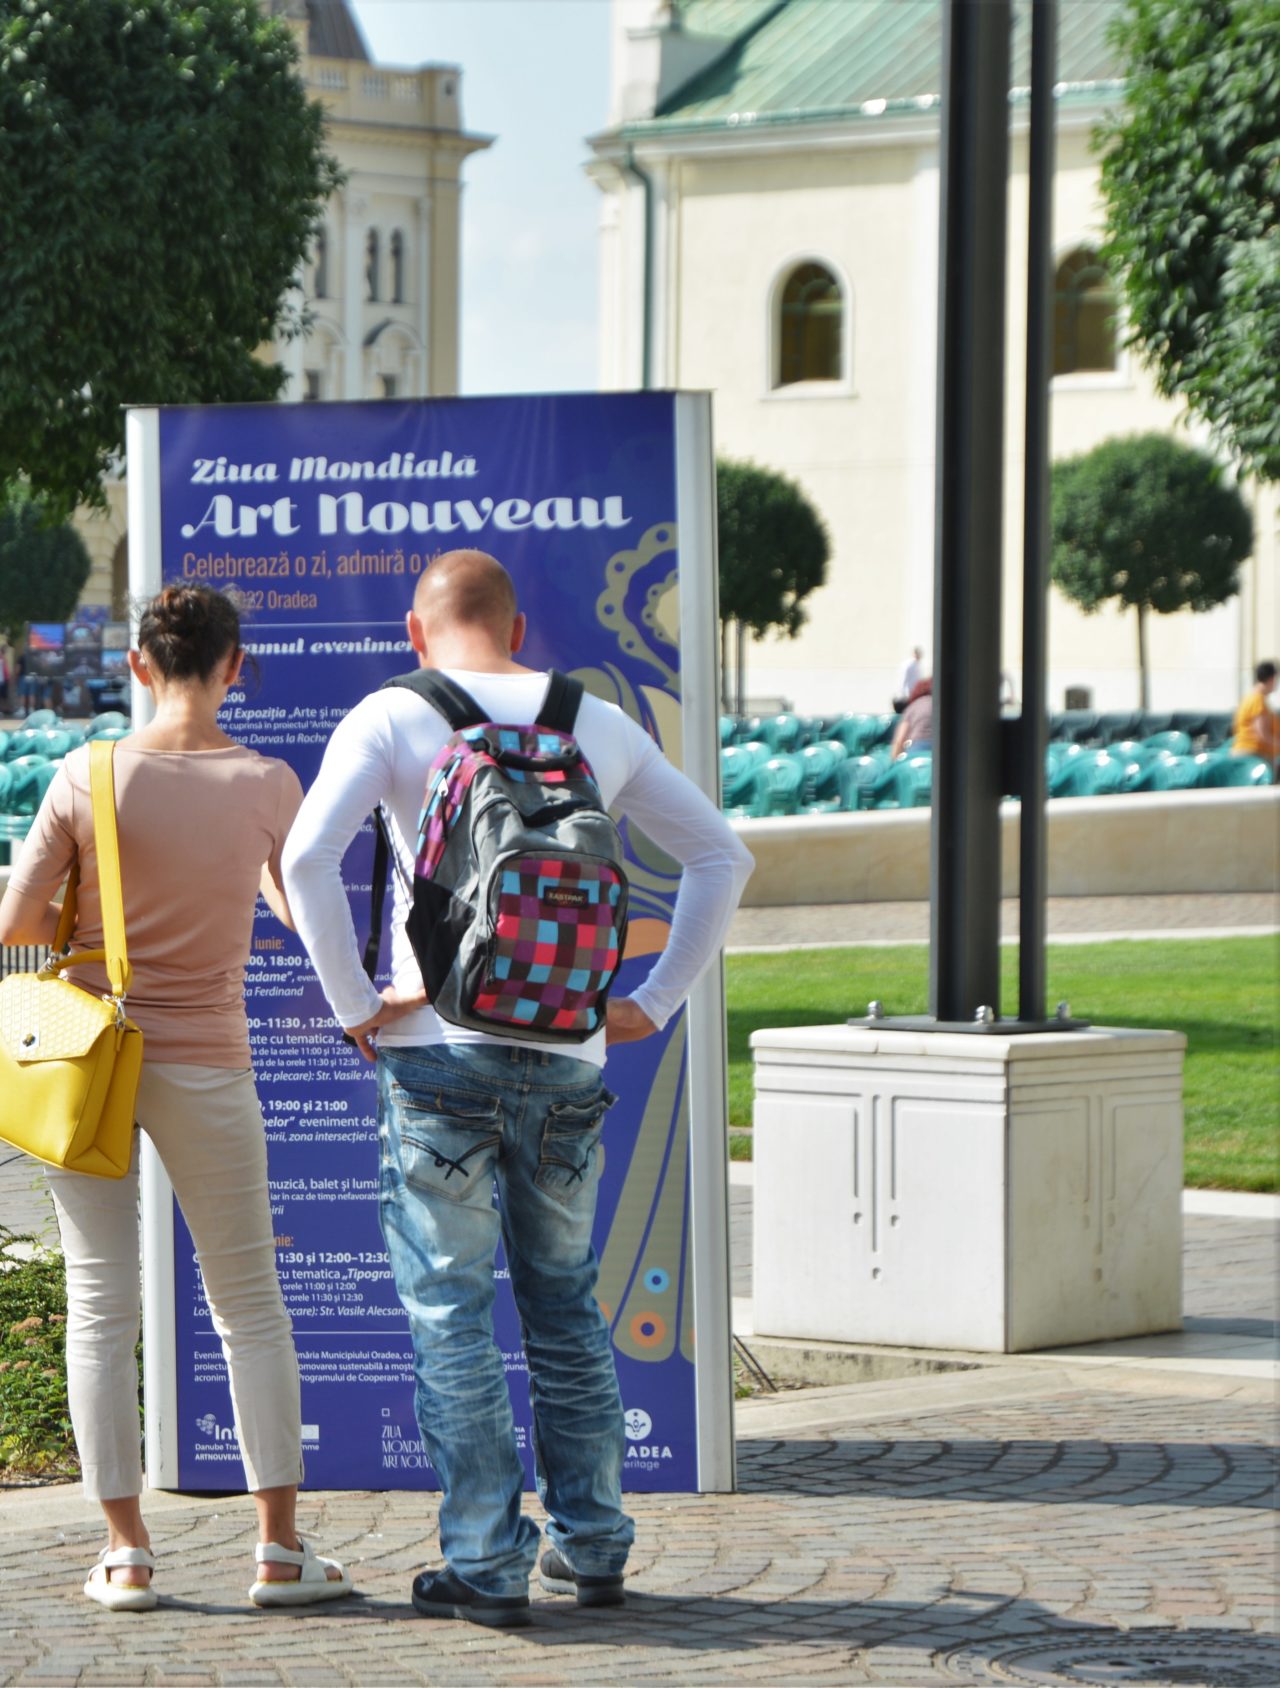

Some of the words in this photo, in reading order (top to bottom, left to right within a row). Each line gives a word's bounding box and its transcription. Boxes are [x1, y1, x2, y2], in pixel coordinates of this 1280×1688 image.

[190, 457, 280, 484] Ziua
[290, 450, 479, 482] Mondială
[180, 493, 301, 539] Art
[320, 491, 633, 537] Nouveau
[183, 551, 291, 579] Celebrează
[294, 559, 306, 577] o
[310, 551, 332, 579] zi,
[337, 550, 405, 576] admiră
[410, 555, 422, 574] o
[268, 589, 317, 609] Oradea
[250, 732, 285, 744] Darvas
[286, 732, 296, 743] la
[297, 732, 328, 743] Roche
[255, 936, 285, 951] iunie:
[271, 955, 302, 966] 18:00
[254, 986, 304, 997] Ferdinand
[270, 1036, 284, 1045] cu
[286, 1034, 335, 1045] tematica
[260, 1047, 269, 1056] de
[270, 1047, 277, 1055] la
[278, 1047, 299, 1056] orele
[301, 1046, 321, 1056] 11:00
[332, 1046, 353, 1055] 12:00
[265, 1058, 275, 1067] de
[277, 1058, 285, 1067] la
[286, 1058, 306, 1067] orele
[308, 1058, 329, 1067] 11:30
[338, 1058, 360, 1067] 12:30
[260, 1070, 272, 1081] de
[316, 1069, 332, 1081] Str.
[334, 1068, 361, 1080] Vasile
[268, 1100, 301, 1111] 19:00
[315, 1100, 348, 1111] 21:00
[299, 1116, 359, 1127] eveniment
[361, 1115, 377, 1127] de
[288, 1133, 313, 1142] zona
[268, 1178, 308, 1191] muzică,
[310, 1178, 338, 1190] balet
[270, 1192, 281, 1201] iar
[305, 1192, 316, 1201] de
[317, 1192, 337, 1203] timp
[292, 1268, 340, 1280] tematica
[282, 1282, 302, 1291] orele
[304, 1282, 325, 1291] 11:00
[335, 1282, 356, 1291] 12:00
[289, 1293, 309, 1303] orele
[311, 1293, 332, 1302] 11:30
[341, 1293, 363, 1302] 12:30
[319, 1305, 335, 1316] Str.
[337, 1304, 365, 1316] Vasile
[321, 1350, 370, 1361] Municipiului
[371, 1350, 402, 1361] Oradea,
[403, 1352, 413, 1360] cu
[338, 1361, 383, 1371] sustenabilă
[194, 1373, 227, 1382] acronim
[346, 1372, 357, 1382] de
[358, 1372, 399, 1384] Cooperare
